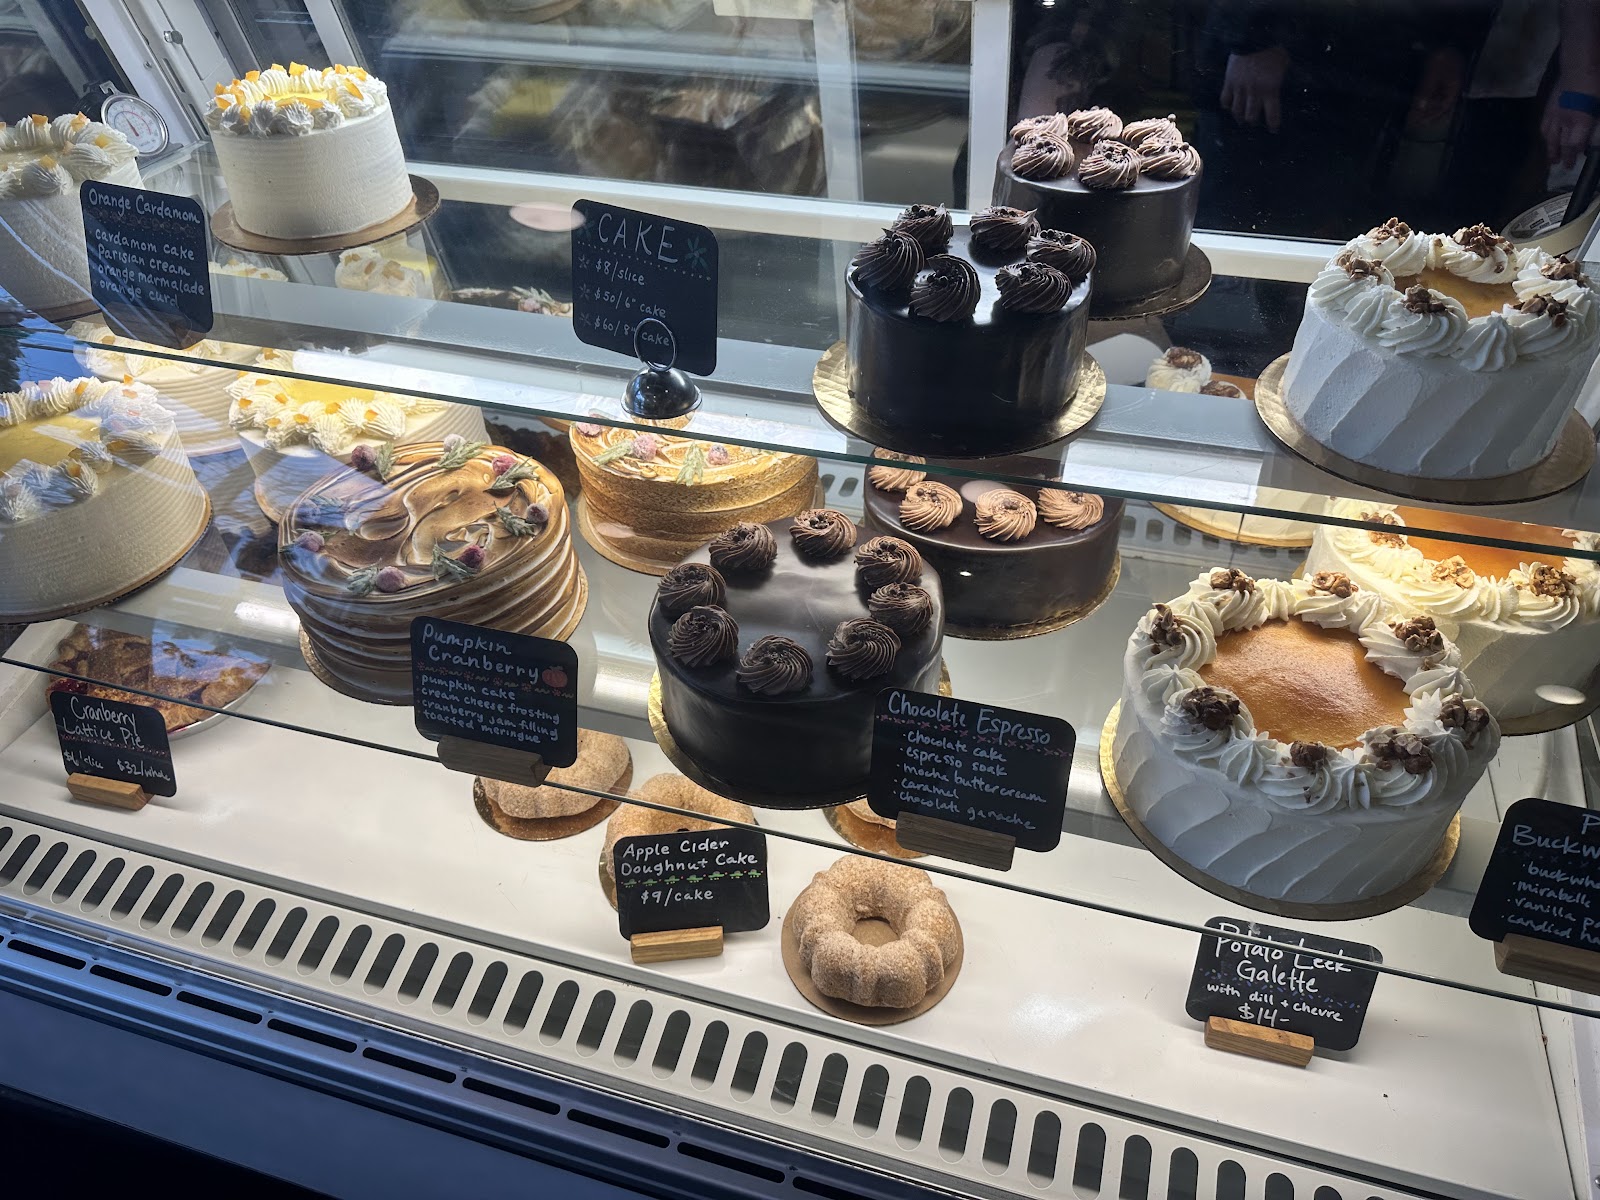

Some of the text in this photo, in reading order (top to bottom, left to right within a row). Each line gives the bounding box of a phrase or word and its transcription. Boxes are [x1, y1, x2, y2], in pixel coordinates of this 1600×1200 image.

[89, 188, 200, 224] Orange Cardamom
[96, 228, 194, 260] cardamom cake
[599, 213, 678, 263] CAKE
[98, 263, 204, 295] orange marmalade
[150, 259, 190, 276] cream
[596, 258, 645, 285] $8/slice
[100, 279, 179, 309] orange curd
[640, 301, 666, 319] cake
[641, 330, 670, 346] cake
[428, 645, 539, 684] Cranberry
[422, 675, 516, 700] pumpkin cake
[71, 696, 137, 736] Cranberry
[421, 687, 560, 725] cream cheese frosting
[422, 699, 558, 742] cranberry jam filling
[888, 690, 1050, 745] Chocolate Espresso
[63, 717, 145, 748] Lattice Pie
[424, 709, 541, 744] toasted meringue
[907, 730, 1007, 762] chocolate cake
[904, 763, 949, 782] mocha
[906, 748, 1008, 776] espresso soak
[901, 777, 959, 799] caramel
[900, 791, 1036, 830] chocolate ganache
[621, 852, 758, 876] Doughnut Cake
[623, 838, 729, 861] Apple Cider
[641, 888, 714, 907] $9/cake
[1515, 898, 1576, 922] vanilla
[1507, 914, 1573, 939] candied
[1216, 923, 1351, 972] Potato Leek
[1236, 960, 1318, 993] Galette
[1207, 983, 1241, 998] with
[1249, 991, 1274, 1005] dill
[1293, 1002, 1343, 1022] chevre
